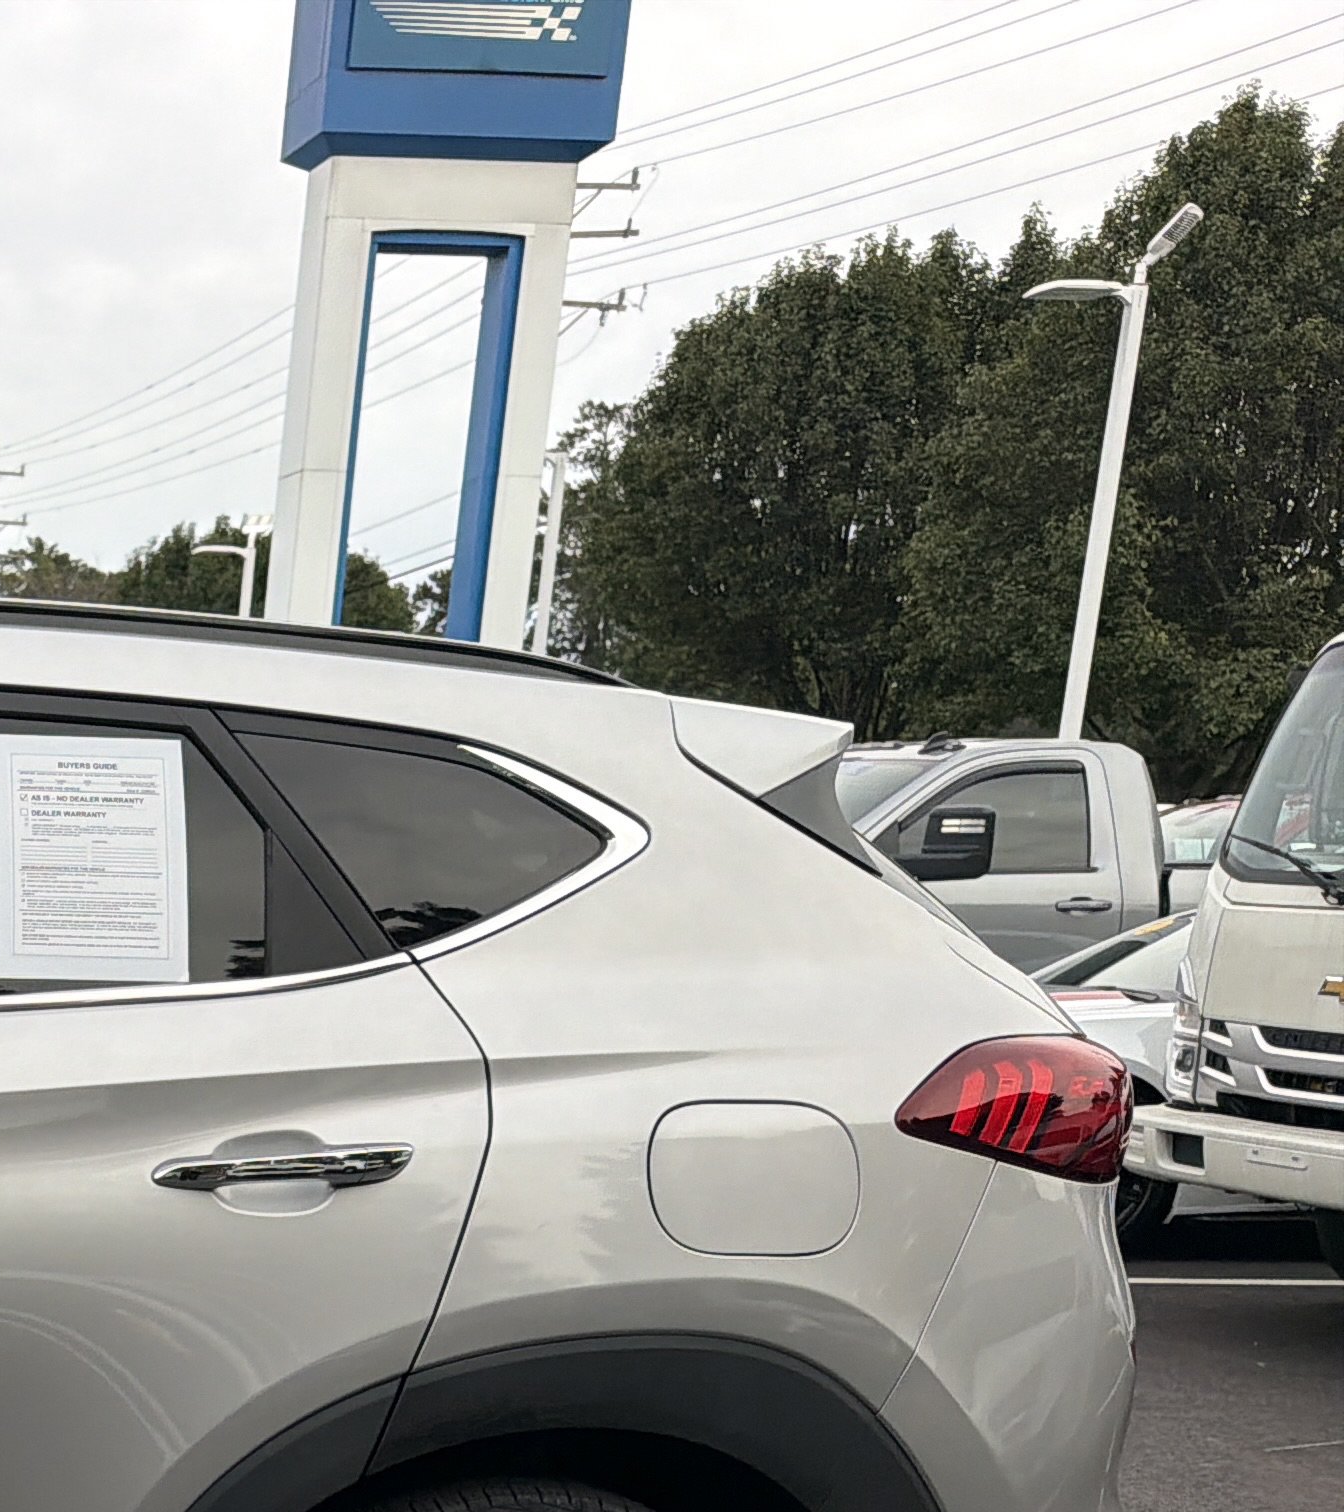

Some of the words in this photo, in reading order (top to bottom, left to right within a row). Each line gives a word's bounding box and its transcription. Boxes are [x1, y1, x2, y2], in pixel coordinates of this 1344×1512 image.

[57, 761, 91, 770] BUYERS
[92, 762, 118, 771] GUIDE
[101, 797, 144, 805] WARRANTY
[63, 811, 107, 819] WARRANTY
